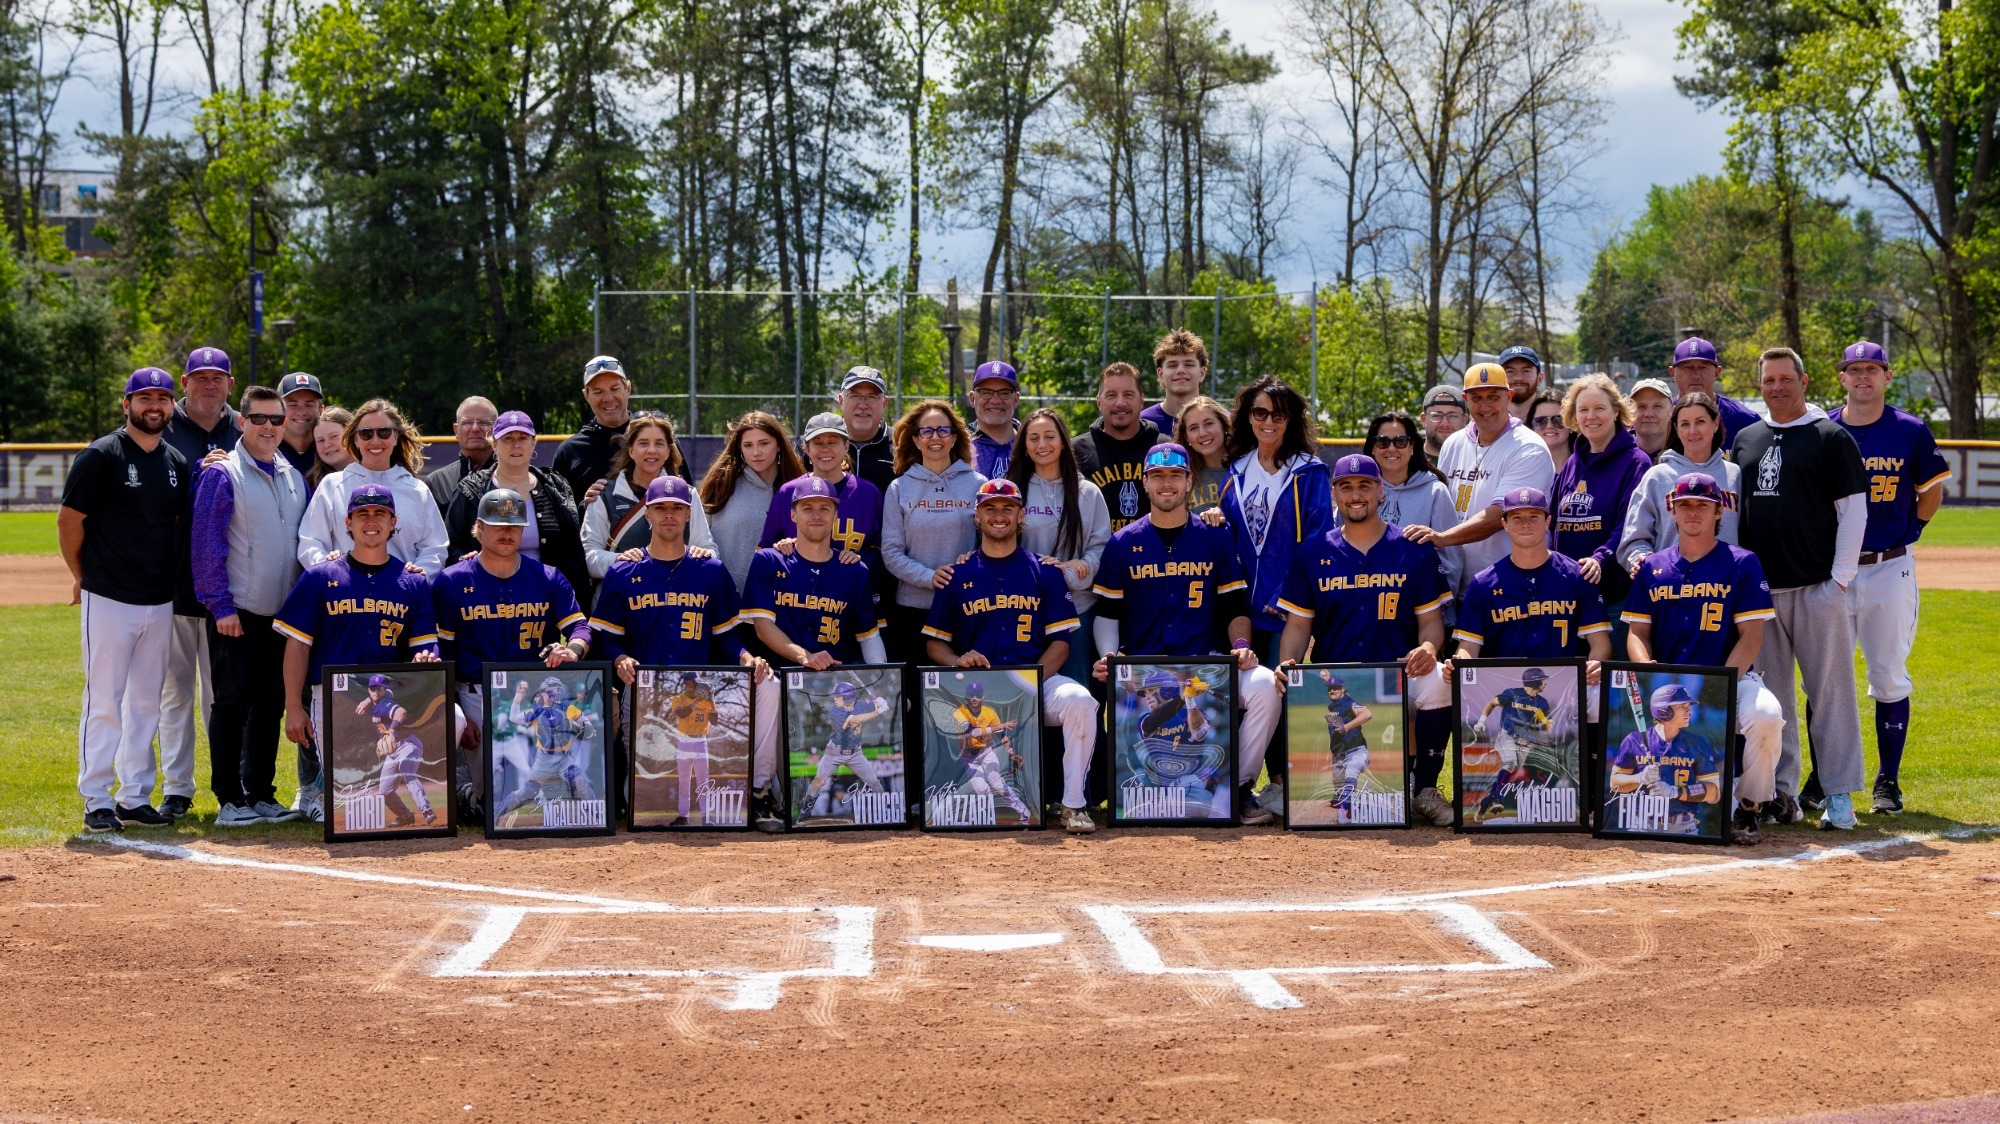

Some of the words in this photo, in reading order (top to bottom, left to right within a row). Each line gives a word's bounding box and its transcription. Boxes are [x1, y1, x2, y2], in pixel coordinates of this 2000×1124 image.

[1092, 463, 1142, 488] UALBA
[1870, 475, 1899, 503] 26
[1574, 521, 1602, 531] DANES
[1129, 562, 1213, 580] UALBANY
[1318, 573, 1407, 593] UALBANY
[628, 592, 709, 611] UALBANY
[962, 594, 1042, 616] UALBANY
[1188, 580, 1204, 608] 5
[1378, 592, 1400, 620] 18
[1649, 583, 1732, 604] UALBANY
[326, 598, 409, 619] UALBANY
[1491, 600, 1577, 624] UALBANY
[1700, 603, 1723, 632] 12
[379, 619, 404, 648] 27
[518, 621, 547, 651] 24
[680, 612, 703, 640] 30
[1016, 614, 1032, 642] 2
[1553, 619, 1568, 648] 7
[1674, 769, 1690, 788] 12
[705, 789, 744, 824] PITTZ
[932, 794, 996, 826] MAZZARA
[1123, 786, 1186, 818] MARIANO
[1517, 787, 1576, 823] MAGGIO
[1618, 793, 1670, 831] FILIPPI
